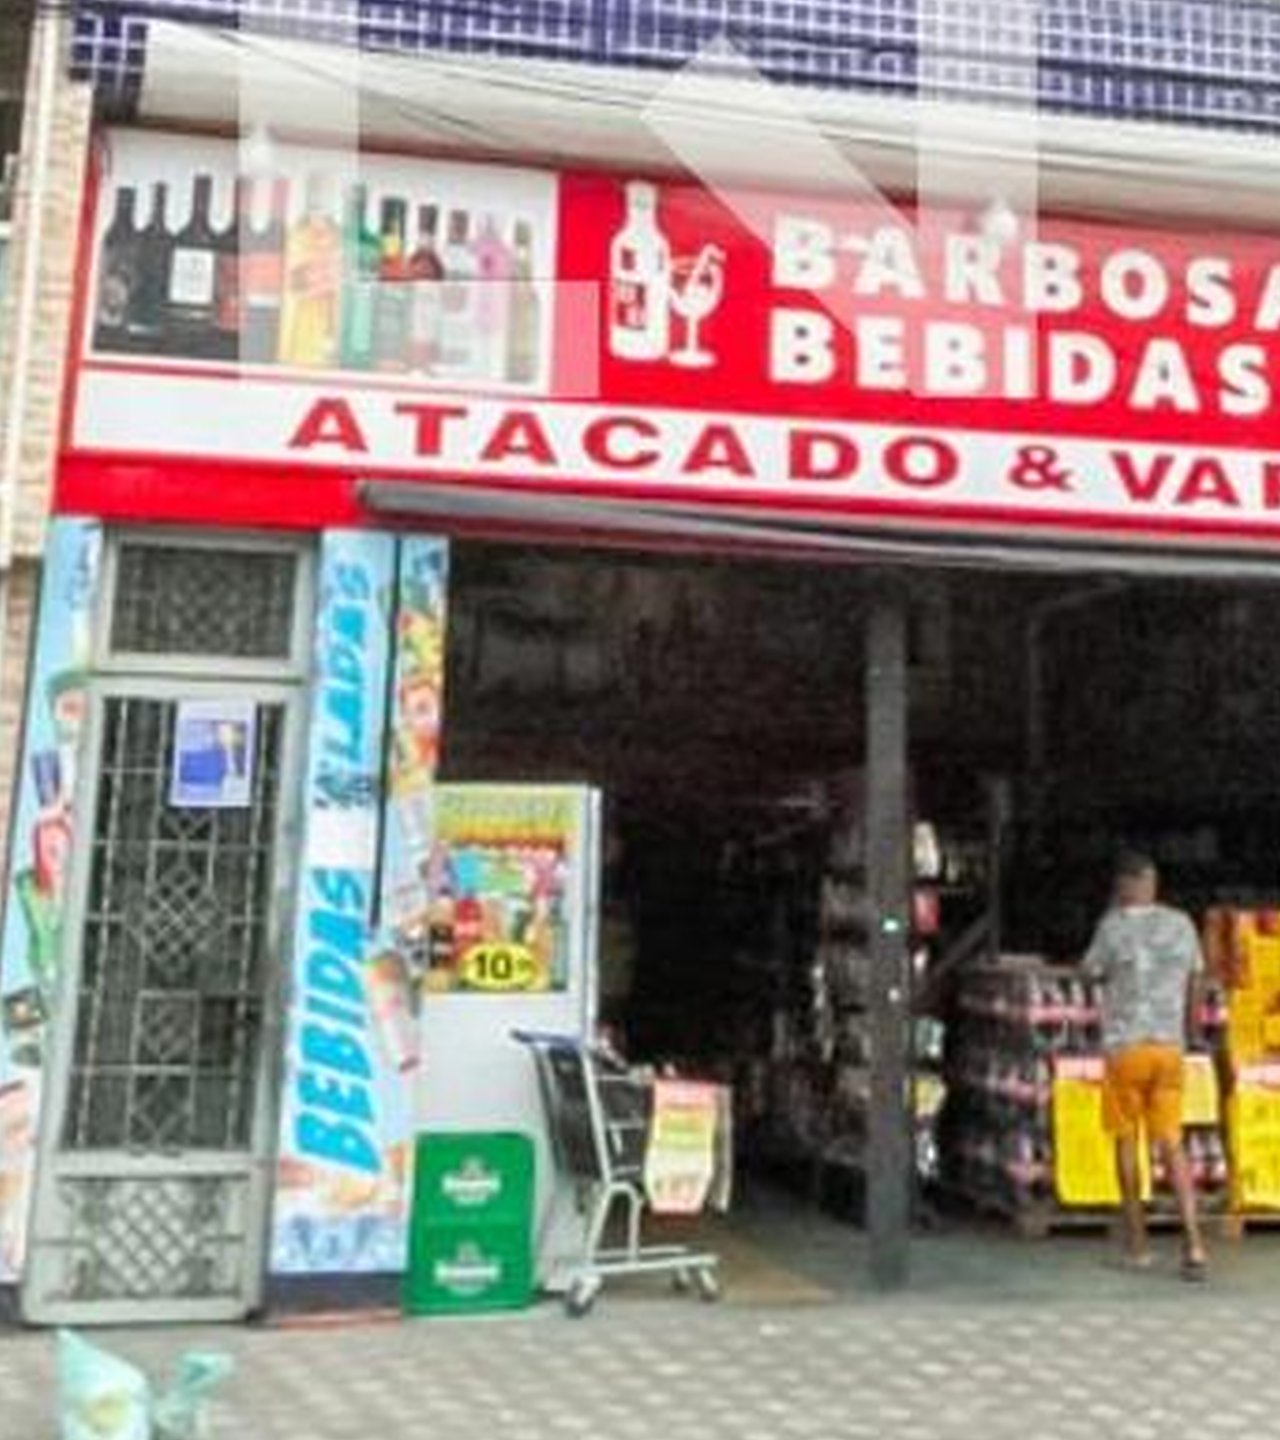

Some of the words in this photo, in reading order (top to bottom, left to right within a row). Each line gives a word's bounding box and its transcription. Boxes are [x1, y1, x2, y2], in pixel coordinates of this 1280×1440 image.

[288, 396, 960, 488] ATACADO
[1008, 445, 1074, 492] &
[768, 310, 1271, 417] BEBIDAS
[314, 561, 372, 808] LADAS
[293, 868, 381, 1175] BEBIDAS
